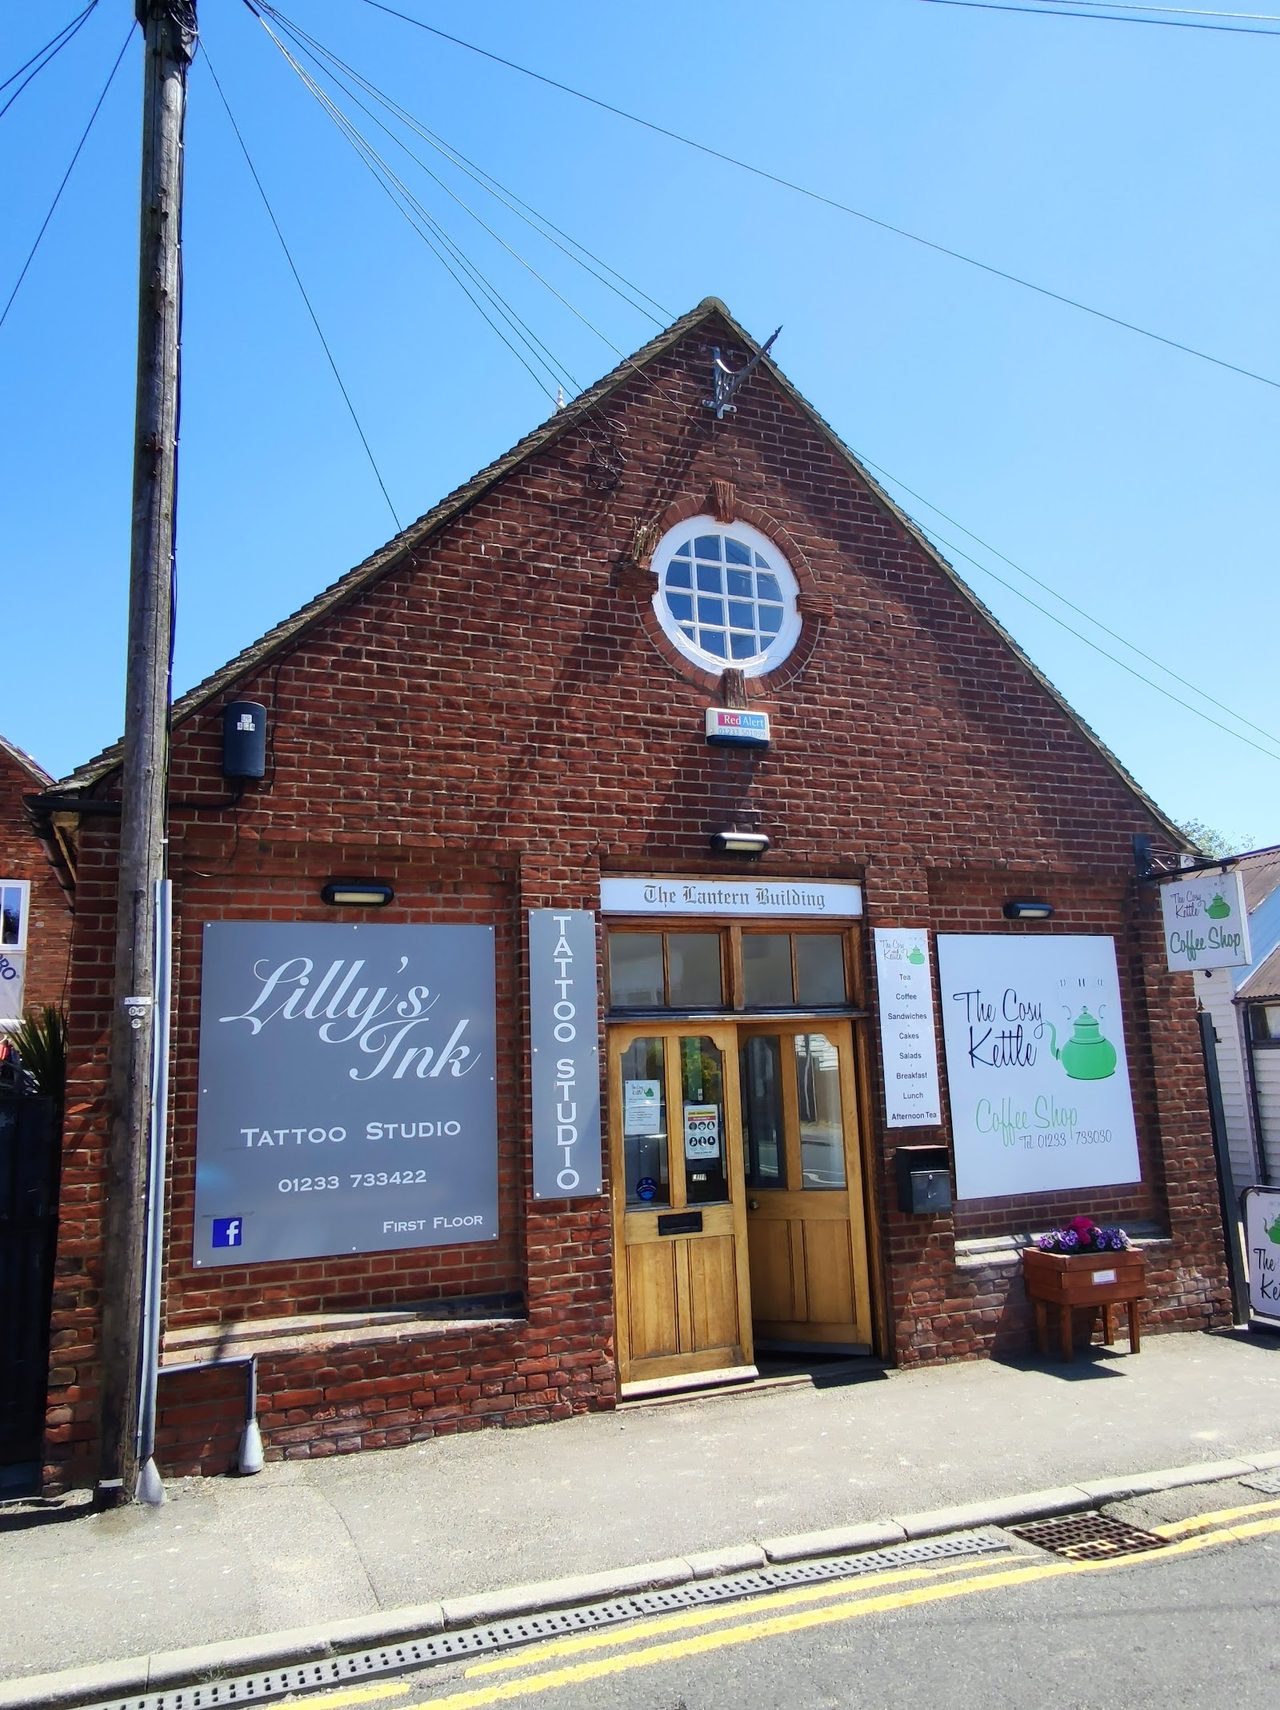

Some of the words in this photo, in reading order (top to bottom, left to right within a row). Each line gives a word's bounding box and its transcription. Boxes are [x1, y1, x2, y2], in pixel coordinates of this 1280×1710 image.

[724, 714, 741, 725] Red
[743, 716, 763, 727] Alert
[644, 884, 676, 907] The
[683, 885, 750, 905] Lantern
[755, 887, 826, 910] Building
[1176, 902, 1199, 919] Kettle
[1170, 929, 1206, 962] Coffee
[1208, 925, 1240, 956] Shop
[553, 915, 577, 1042] TATTOO
[218, 955, 441, 1043] Lilly's
[887, 1012, 927, 1020] Sandwiches
[953, 989, 997, 1023] The
[1002, 988, 1045, 1039] Cosy
[898, 1032, 919, 1040] Cakes
[968, 1024, 1038, 1069] Kettle
[349, 1017, 482, 1081] Ink
[899, 1052, 922, 1060] Salads
[896, 1072, 928, 1080] Breakfast
[902, 1092, 924, 1100] Lunch
[556, 1059, 580, 1190] STUDIO
[976, 1097, 1029, 1147] Coffee
[1034, 1095, 1079, 1140] Shop
[1037, 1132, 1067, 1149] 01233
[1075, 1129, 1113, 1145] 733030
[278, 1174, 340, 1193] 01233
[350, 1169, 427, 1189] 733422
[1253, 1248, 1276, 1272] The
[1260, 1273, 1280, 1301] Ke
